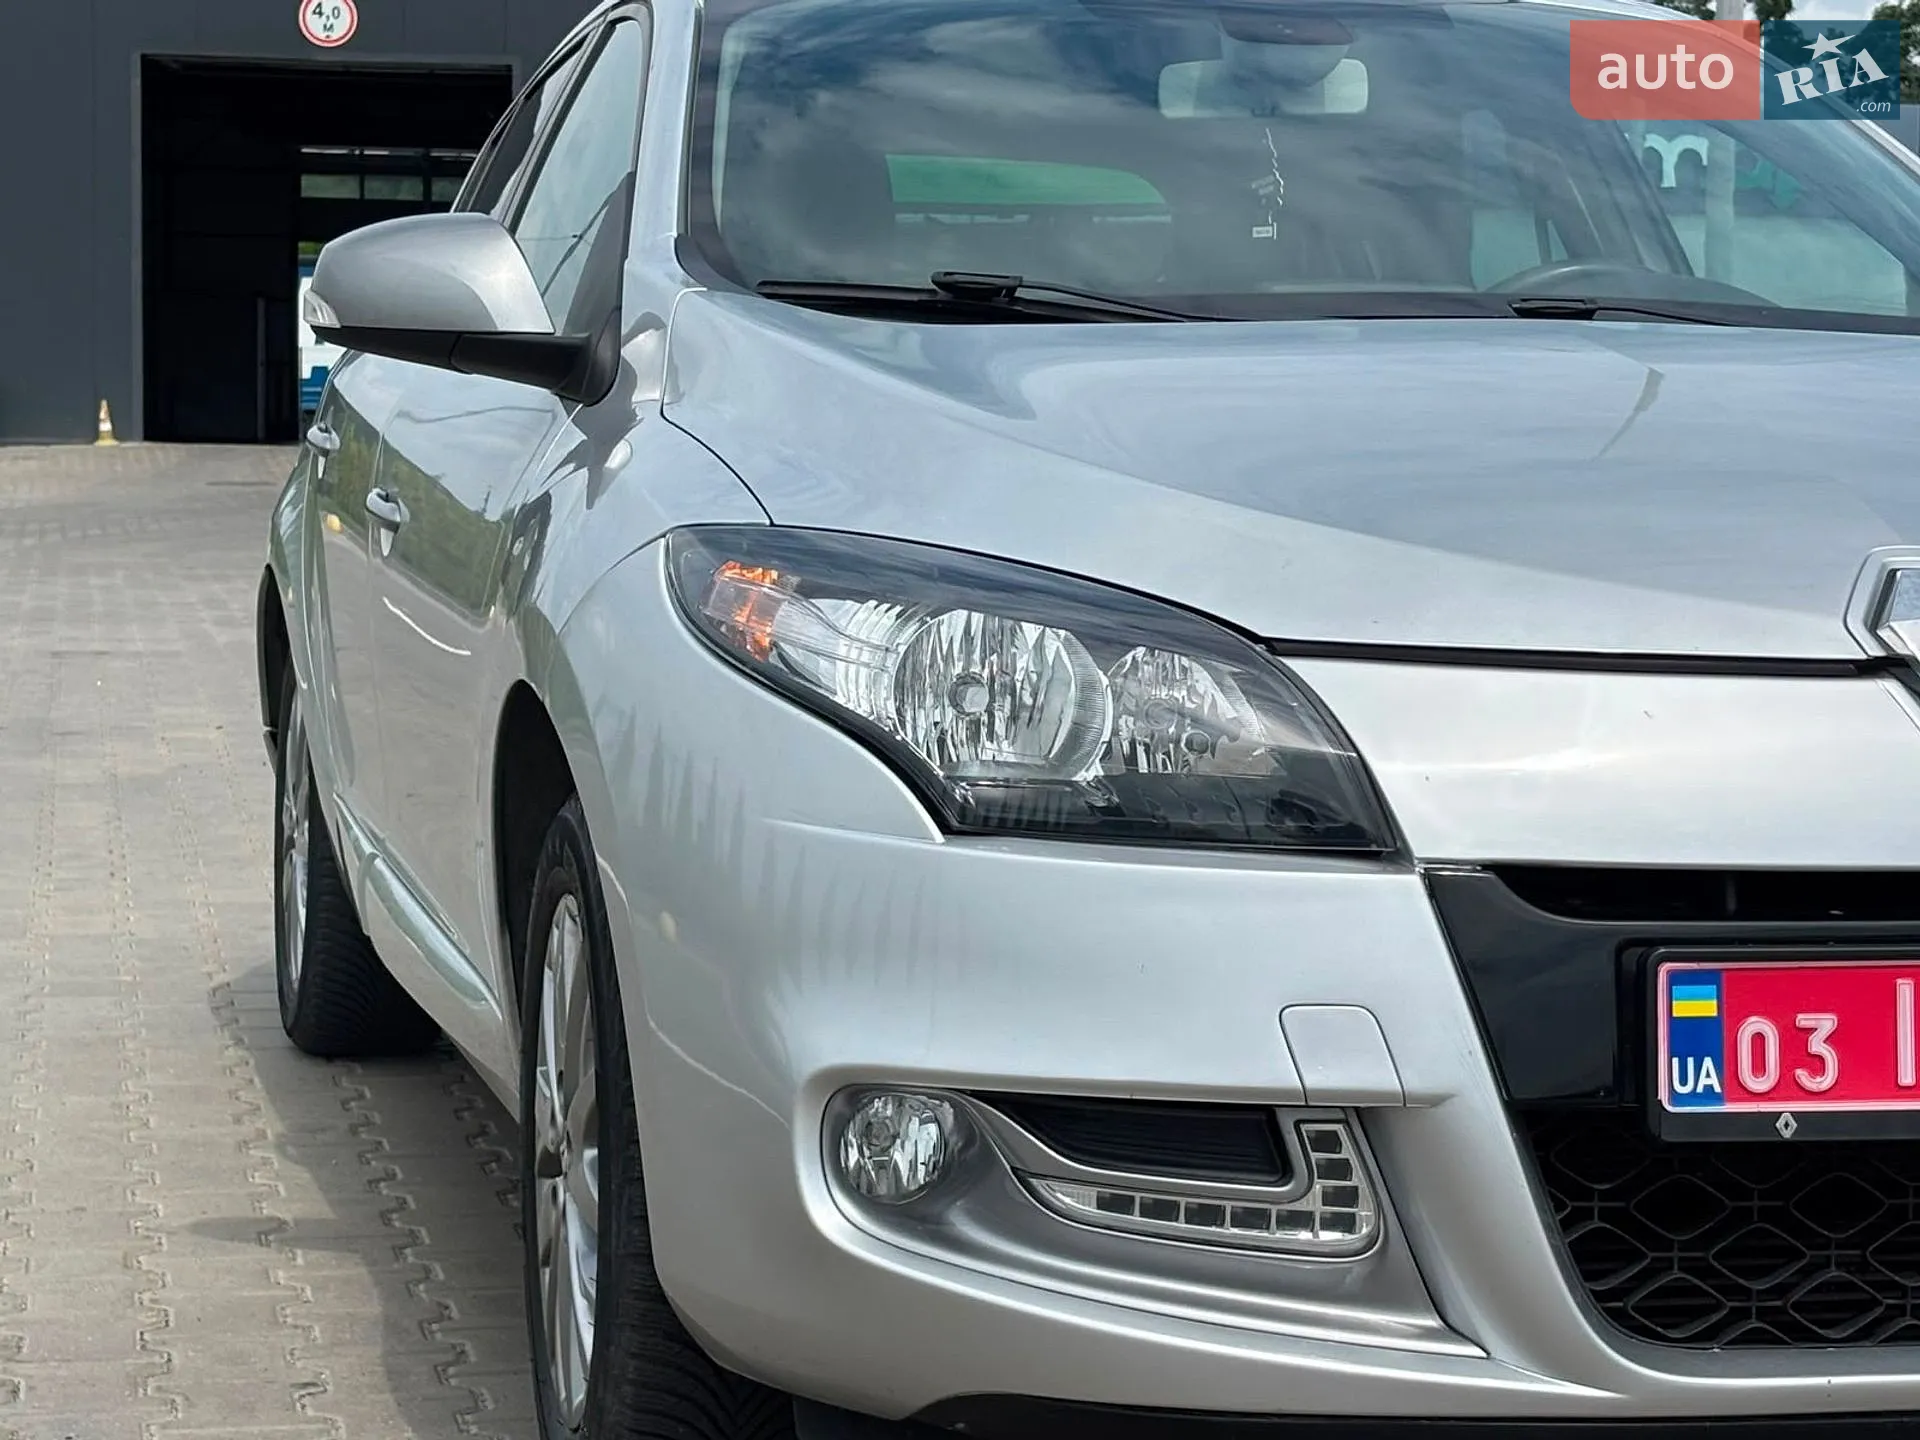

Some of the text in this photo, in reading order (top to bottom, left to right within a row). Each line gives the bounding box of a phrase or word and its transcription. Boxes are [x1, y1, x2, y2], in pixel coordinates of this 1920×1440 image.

[312, 2, 341, 21] 4,0
[1672, 1056, 1722, 1094] UA
[1736, 1013, 1839, 1094] 03
